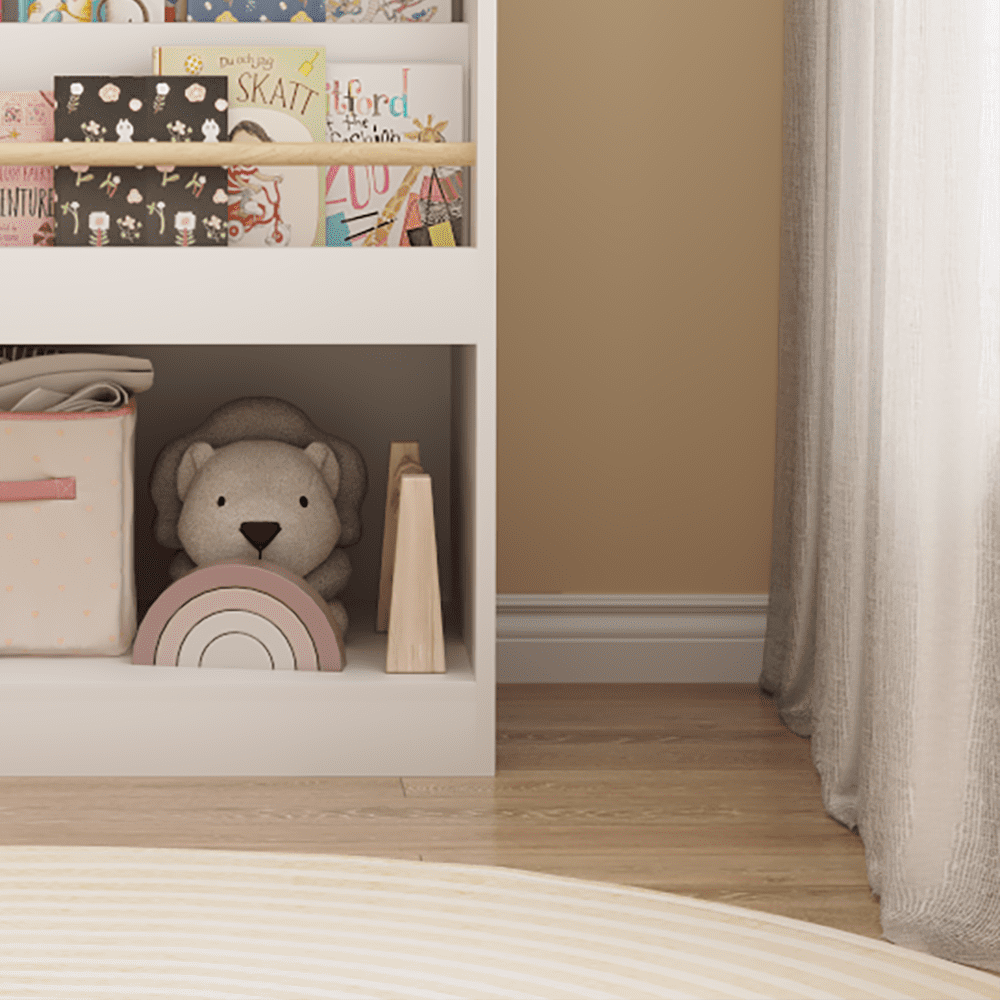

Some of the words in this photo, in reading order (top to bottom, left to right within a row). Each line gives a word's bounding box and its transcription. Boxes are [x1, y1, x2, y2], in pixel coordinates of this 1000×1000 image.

[219, 56, 235, 69] Du
[236, 70, 320, 116] SKATT
[326, 67, 410, 119] itford
